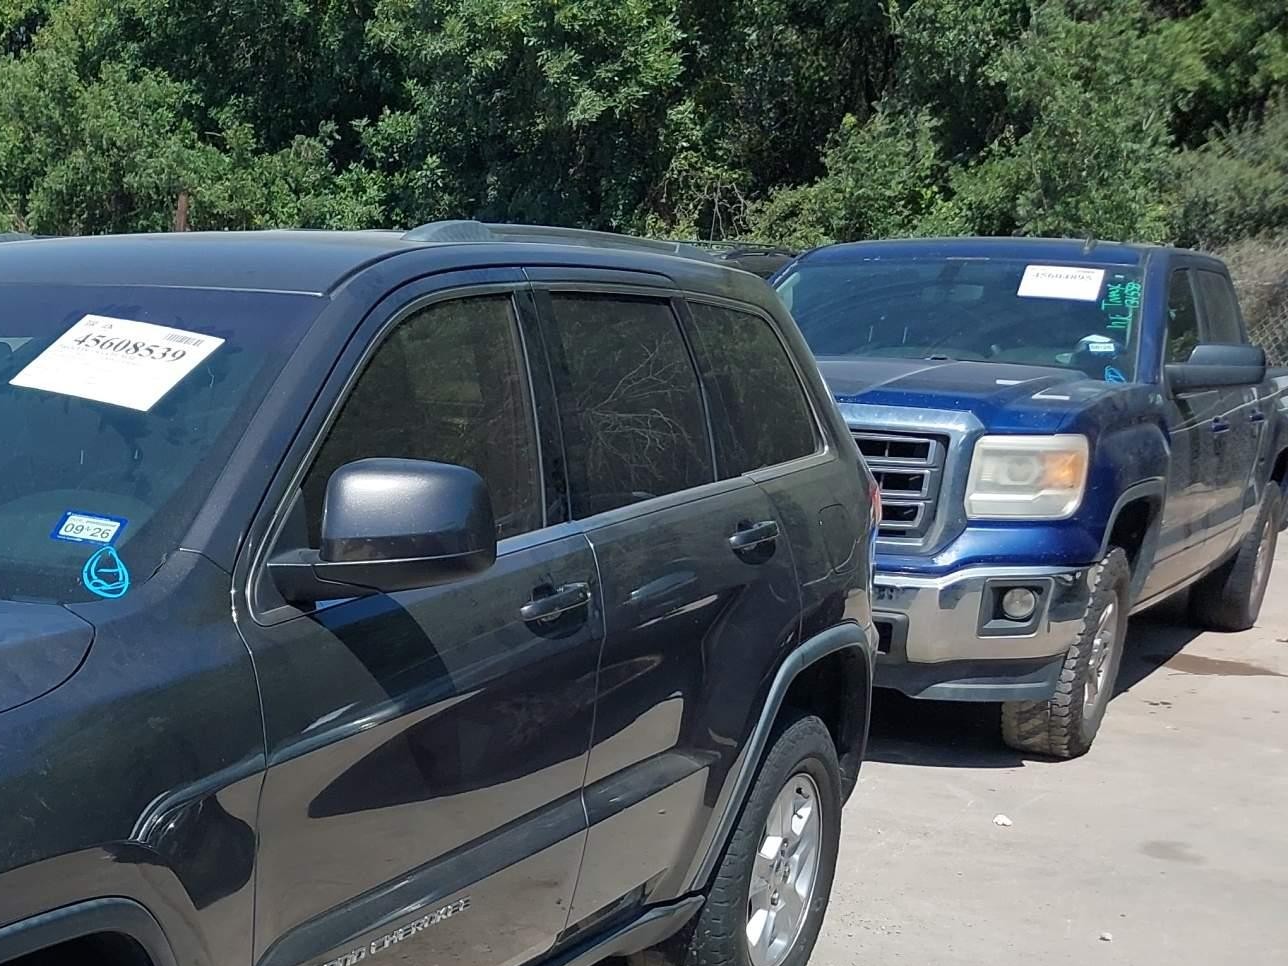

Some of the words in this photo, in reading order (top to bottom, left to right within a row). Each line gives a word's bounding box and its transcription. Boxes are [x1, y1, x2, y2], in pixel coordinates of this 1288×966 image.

[74, 333, 187, 362] 45608539
[64, 523, 85, 535] 09
[89, 527, 112, 539] 26
[370, 896, 472, 954] CHEROKEE
